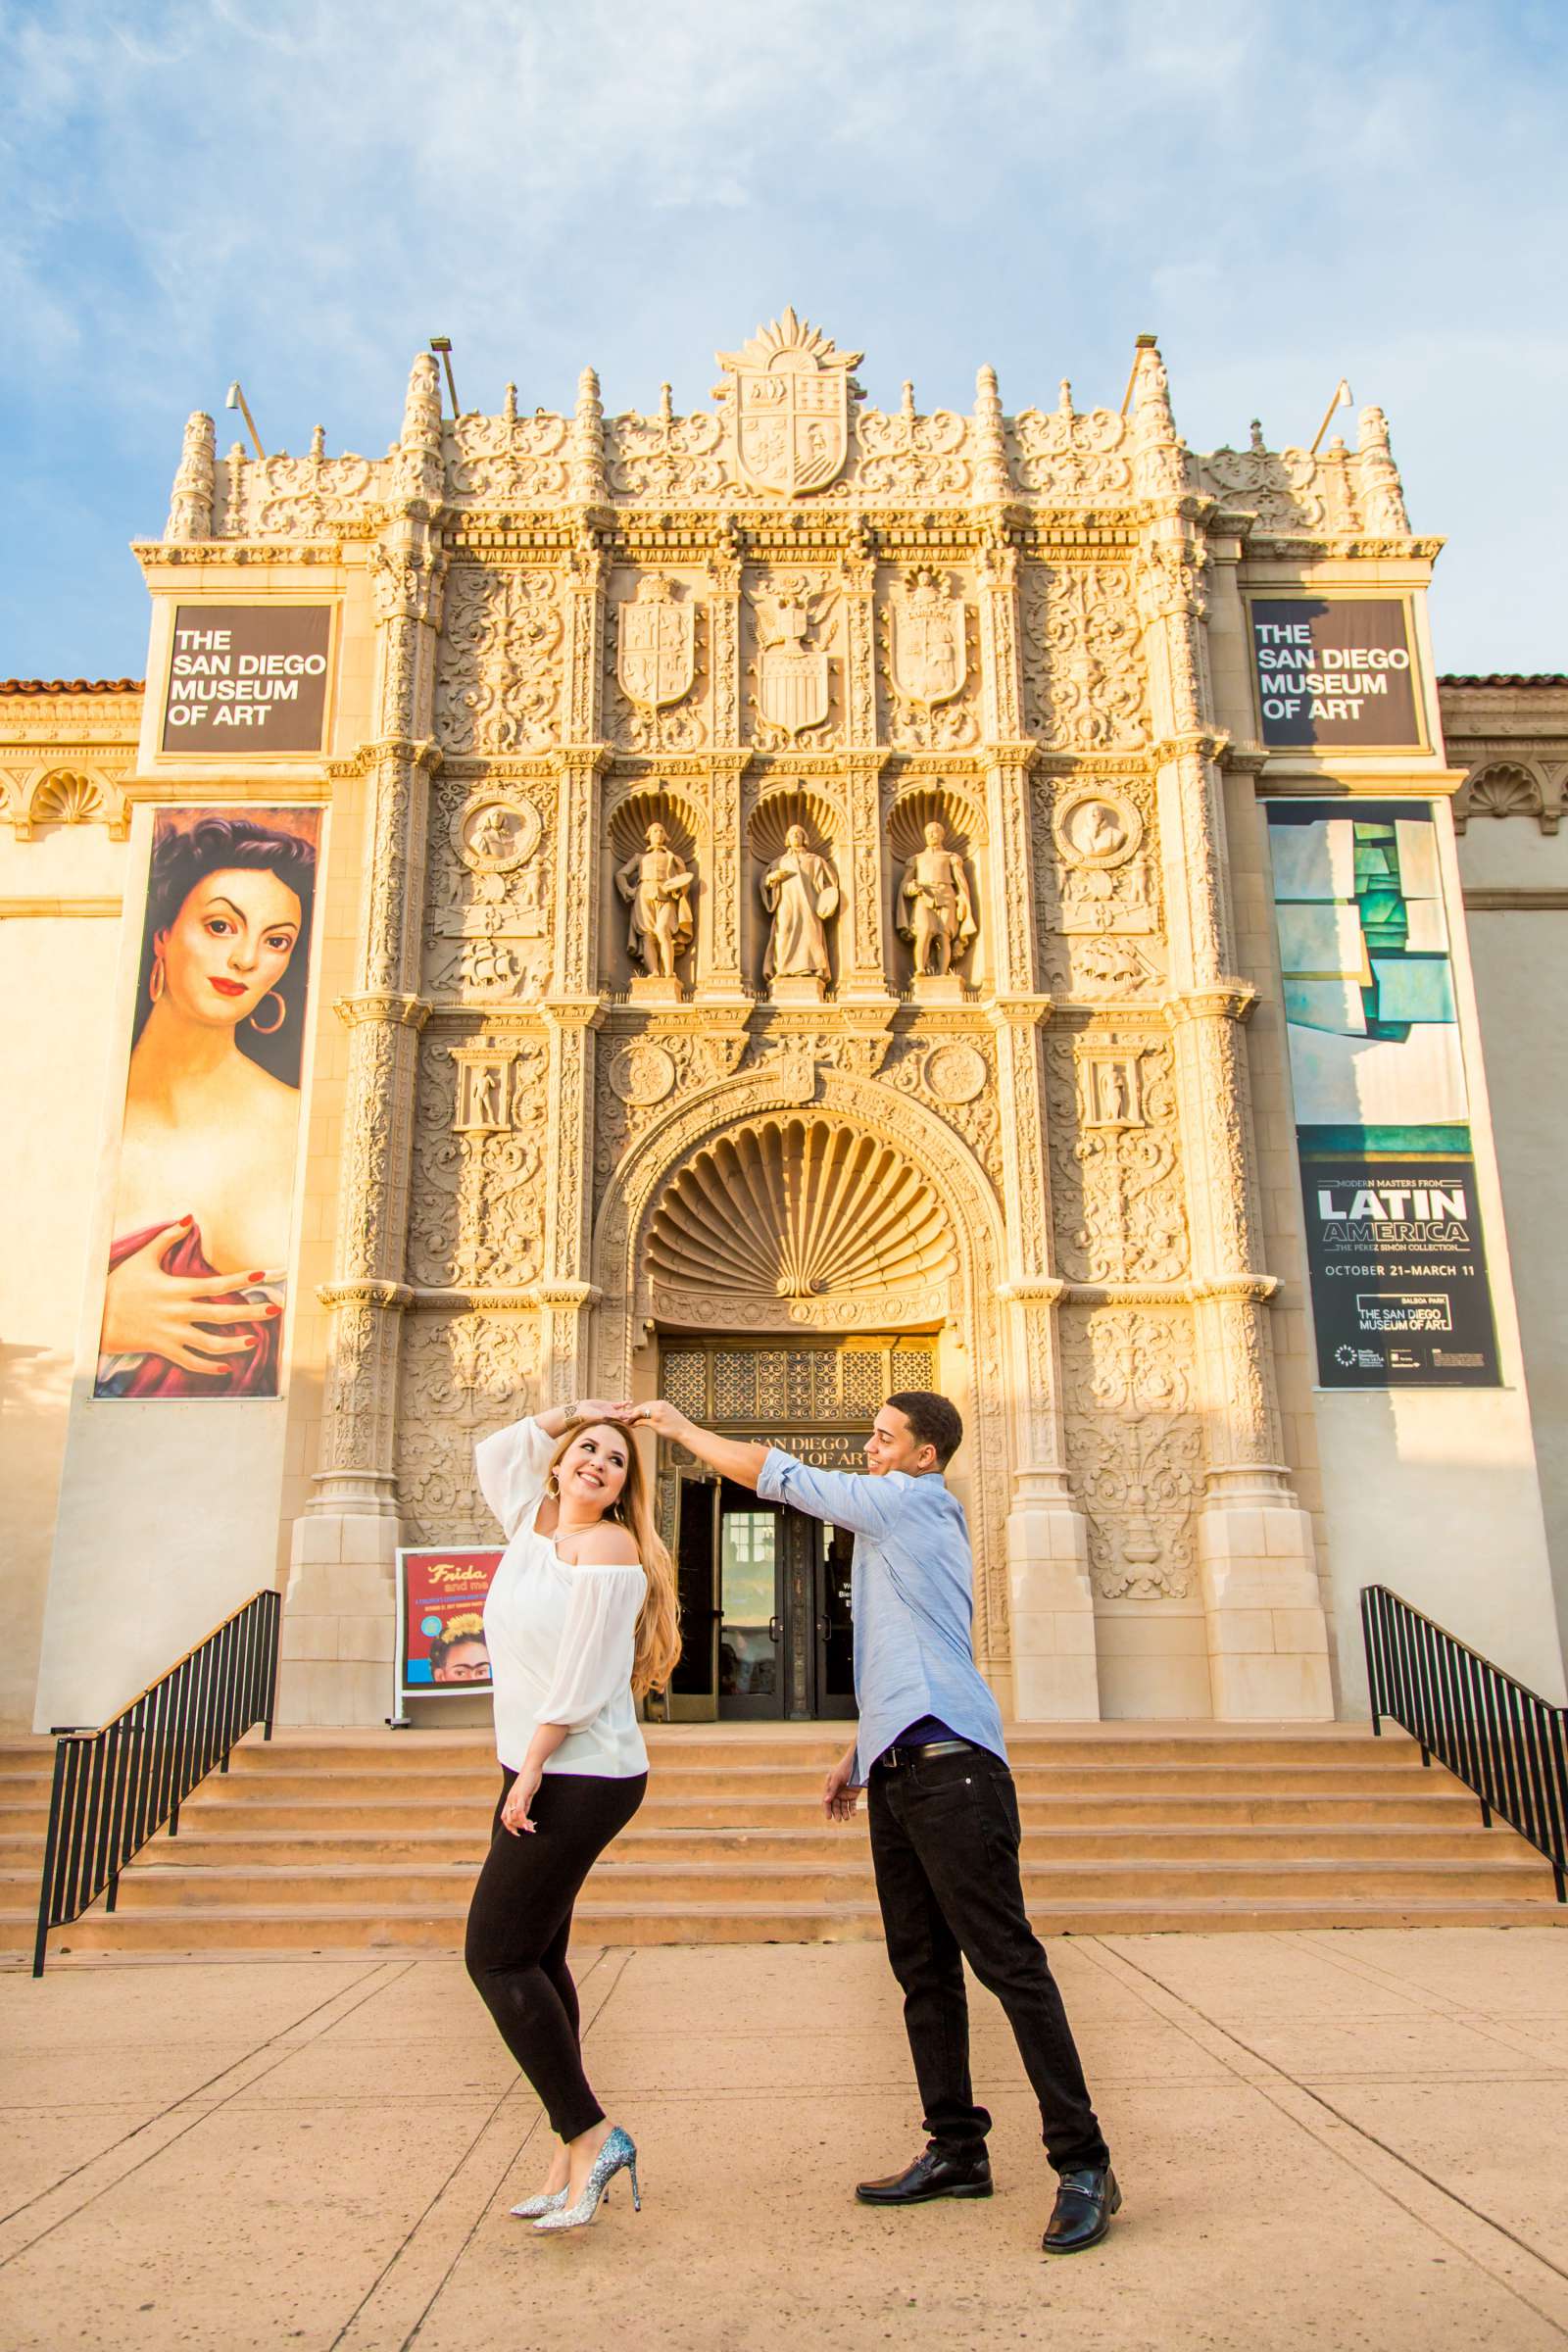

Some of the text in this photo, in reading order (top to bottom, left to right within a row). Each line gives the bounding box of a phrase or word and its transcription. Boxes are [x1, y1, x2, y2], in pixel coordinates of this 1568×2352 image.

[175, 630, 231, 651] THE
[1255, 624, 1311, 644] THE
[172, 655, 326, 675] SAN DIEGO
[1258, 649, 1409, 669] SAN DIEGO
[171, 680, 299, 701] MUSEUM
[1260, 674, 1388, 695] MUSEUM
[168, 706, 271, 726] OF ART
[1263, 699, 1364, 719] OF ART
[1338, 1179, 1444, 1188] MODERN MASTERS FROM
[1318, 1190, 1467, 1220] LATIN
[1323, 1222, 1470, 1242] AMERICA
[1325, 1265, 1385, 1276] OCTOBER
[1461, 1265, 1475, 1276] 11
[1359, 1309, 1442, 1320] THE SAN DIEGO
[1359, 1320, 1446, 1331] MUSEUM OF ART
[792, 1438, 850, 1450] DIEGO
[808, 1452, 834, 1465] OF
[427, 1563, 487, 1584] Frida
[444, 1580, 467, 1592] and
